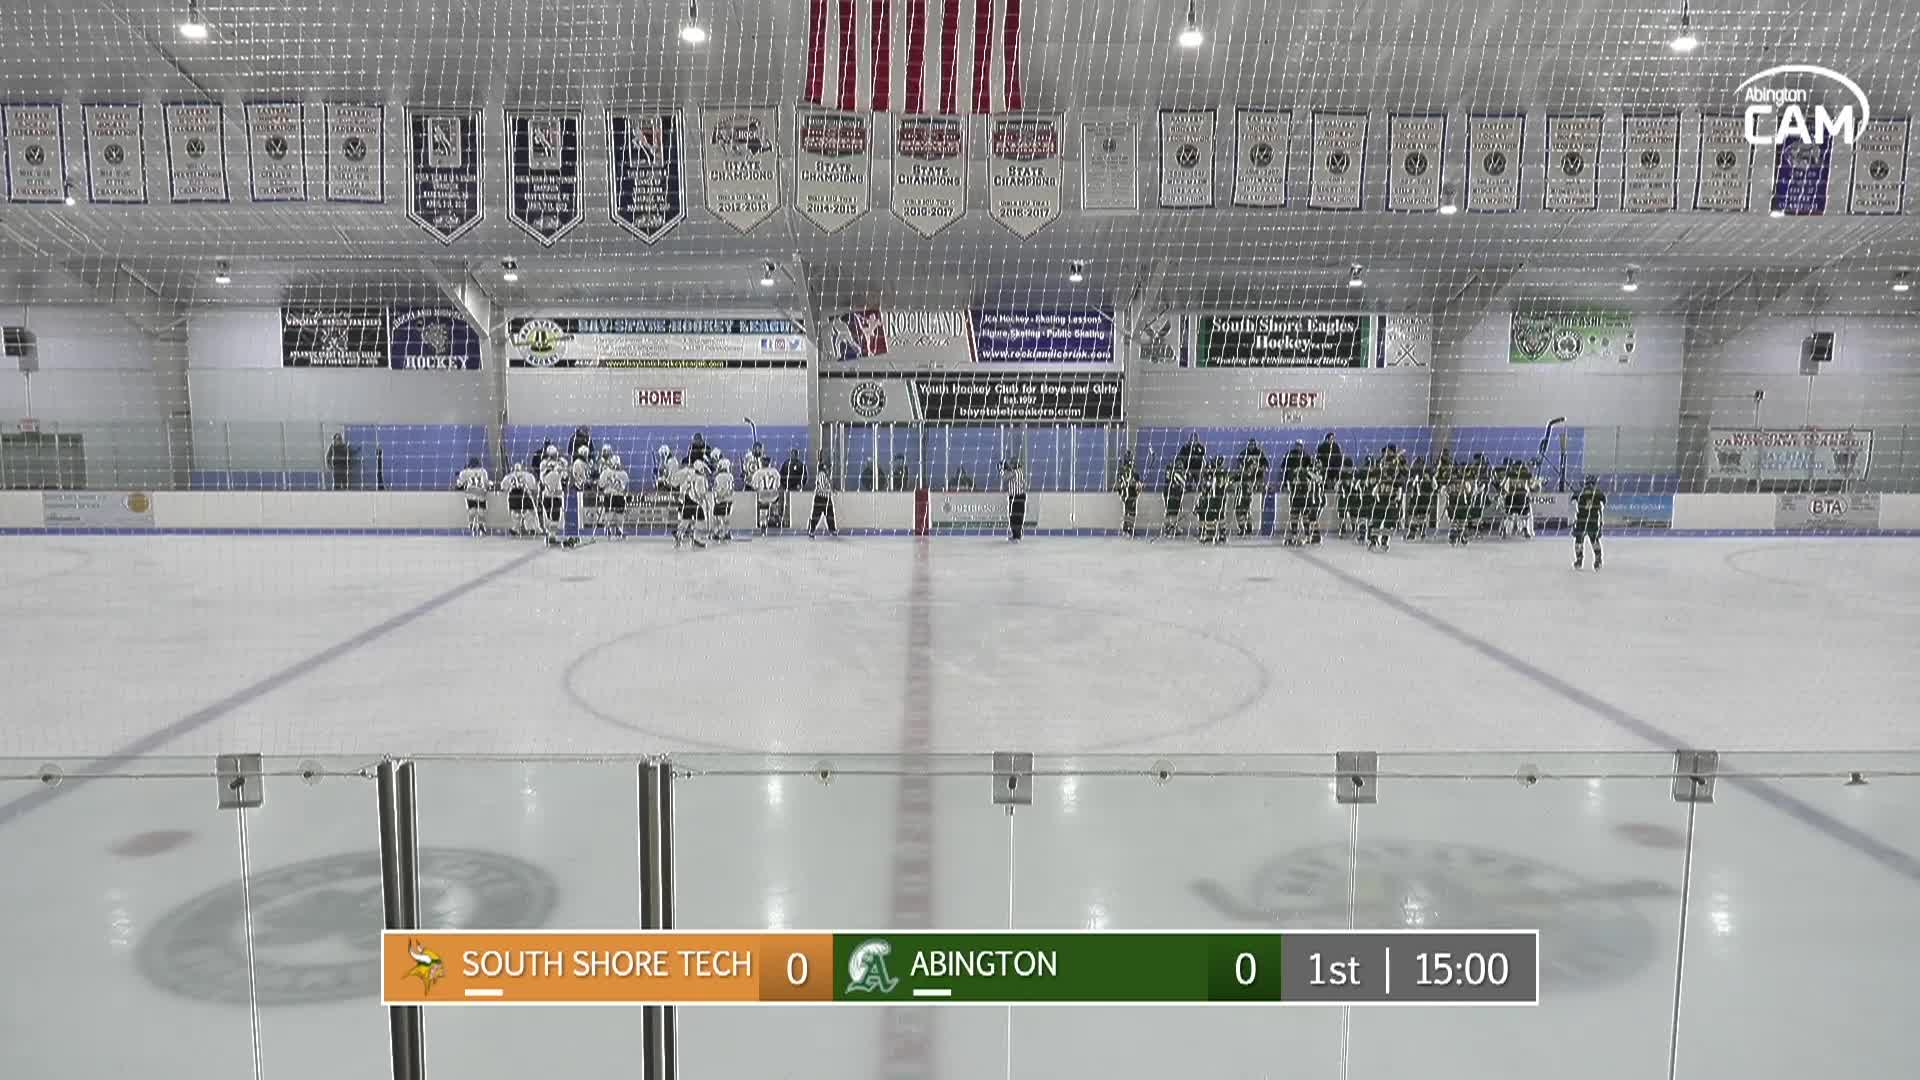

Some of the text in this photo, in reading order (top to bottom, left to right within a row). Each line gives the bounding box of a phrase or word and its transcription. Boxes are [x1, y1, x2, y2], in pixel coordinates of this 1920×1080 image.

[723, 160, 761, 170] STATE
[817, 162, 852, 172] STATE
[912, 165, 950, 174] STATE
[710, 170, 774, 180] CHAMPIONS
[801, 170, 864, 183] CHAMPIONS
[1008, 167, 1044, 176] STATE
[899, 174, 961, 186] CHAMPIONS
[994, 176, 1057, 186] CHAMPIONS
[806, 204, 857, 214] 2014-2015
[613, 319, 666, 333] STATE
[669, 319, 733, 333] HOCKEY
[886, 311, 964, 337] ROCKLAND
[984, 314, 998, 324] Ice
[1000, 314, 1030, 326] Hockey
[1068, 314, 1102, 323] Lessons
[1212, 318, 1354, 336] South Shore Eagles
[1046, 328, 1072, 338] Public
[1074, 328, 1105, 340] Skating
[1255, 335, 1311, 352] Hockey
[982, 350, 1112, 359] www.rocklandicerink.com
[405, 356, 469, 368] HOCKEY
[920, 384, 1118, 396] Youth Hockey Club for Boys and Girls
[638, 391, 682, 404] HOME
[1267, 392, 1318, 407] GUEST
[1811, 500, 1841, 514] BTA
